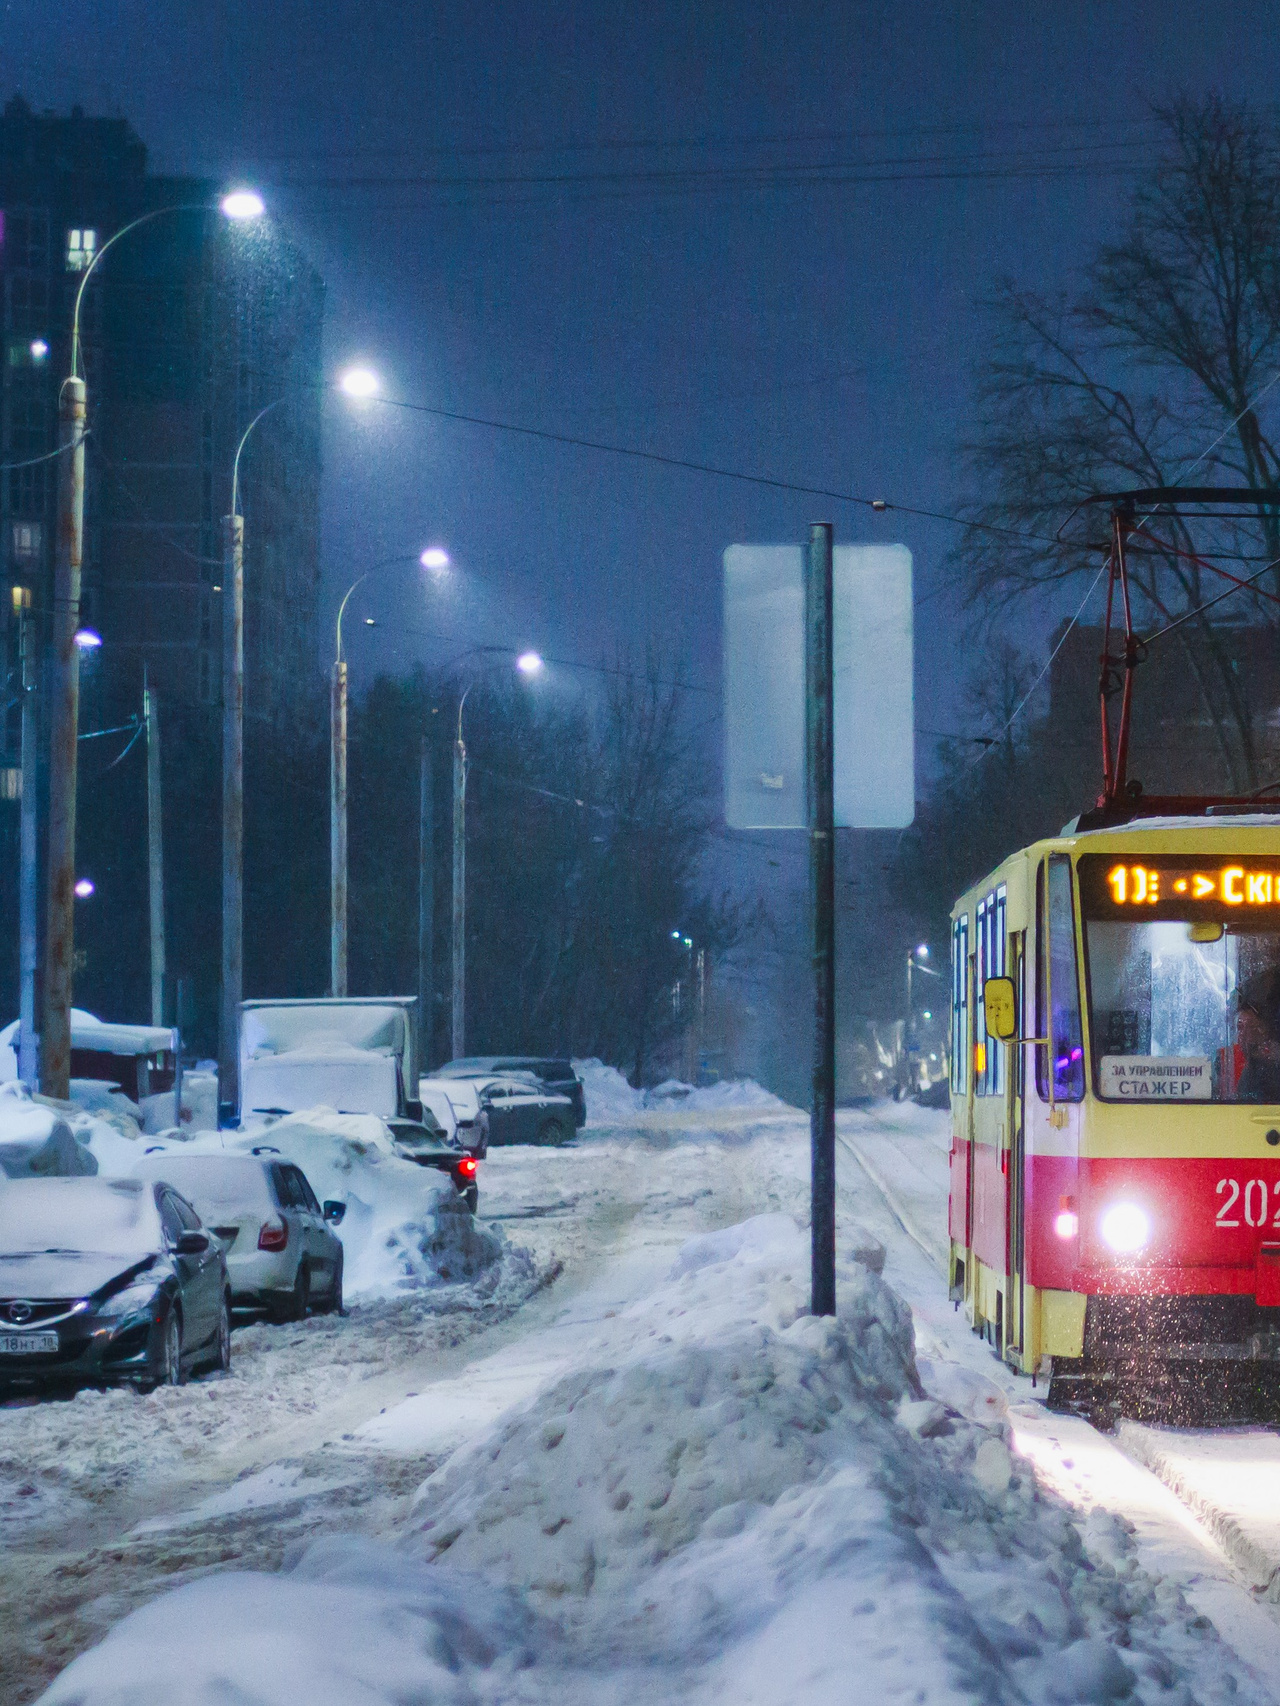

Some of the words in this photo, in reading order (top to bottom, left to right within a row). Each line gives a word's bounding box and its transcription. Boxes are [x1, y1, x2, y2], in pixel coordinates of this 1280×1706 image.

[1112, 1065, 1126, 1076] ЗА
[1129, 1065, 1203, 1077] УПРАВЛЕНИЕМ
[1119, 1081, 1192, 1095] СТАЖЕР
